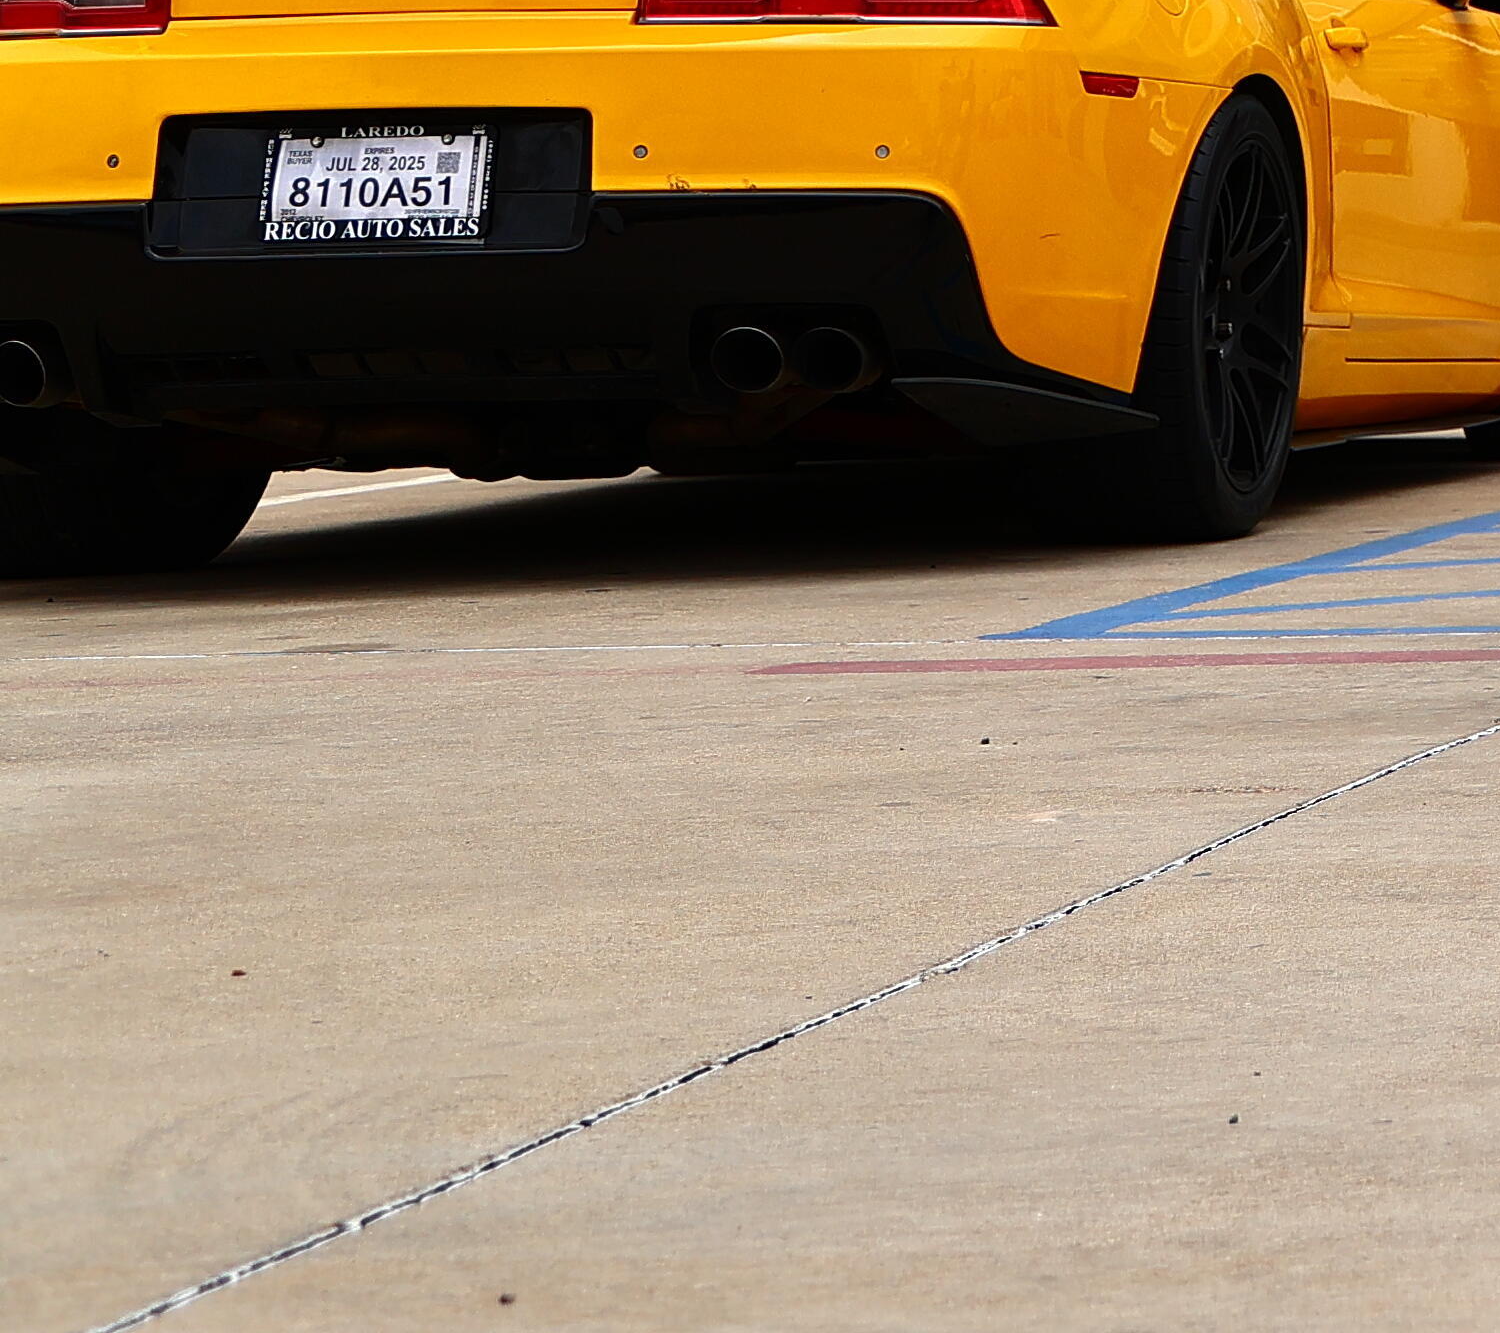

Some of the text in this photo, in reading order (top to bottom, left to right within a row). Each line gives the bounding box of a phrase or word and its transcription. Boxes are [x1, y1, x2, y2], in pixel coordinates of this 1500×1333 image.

[341, 125, 425, 138] LAREDO
[288, 150, 313, 158] TEXAS
[364, 147, 395, 155] EXPIRES
[287, 157, 312, 165] BUYER
[326, 155, 426, 173] JUL 28, 2025
[288, 176, 453, 208] 8110A51
[264, 218, 480, 241] RECIO AUTO SALES
